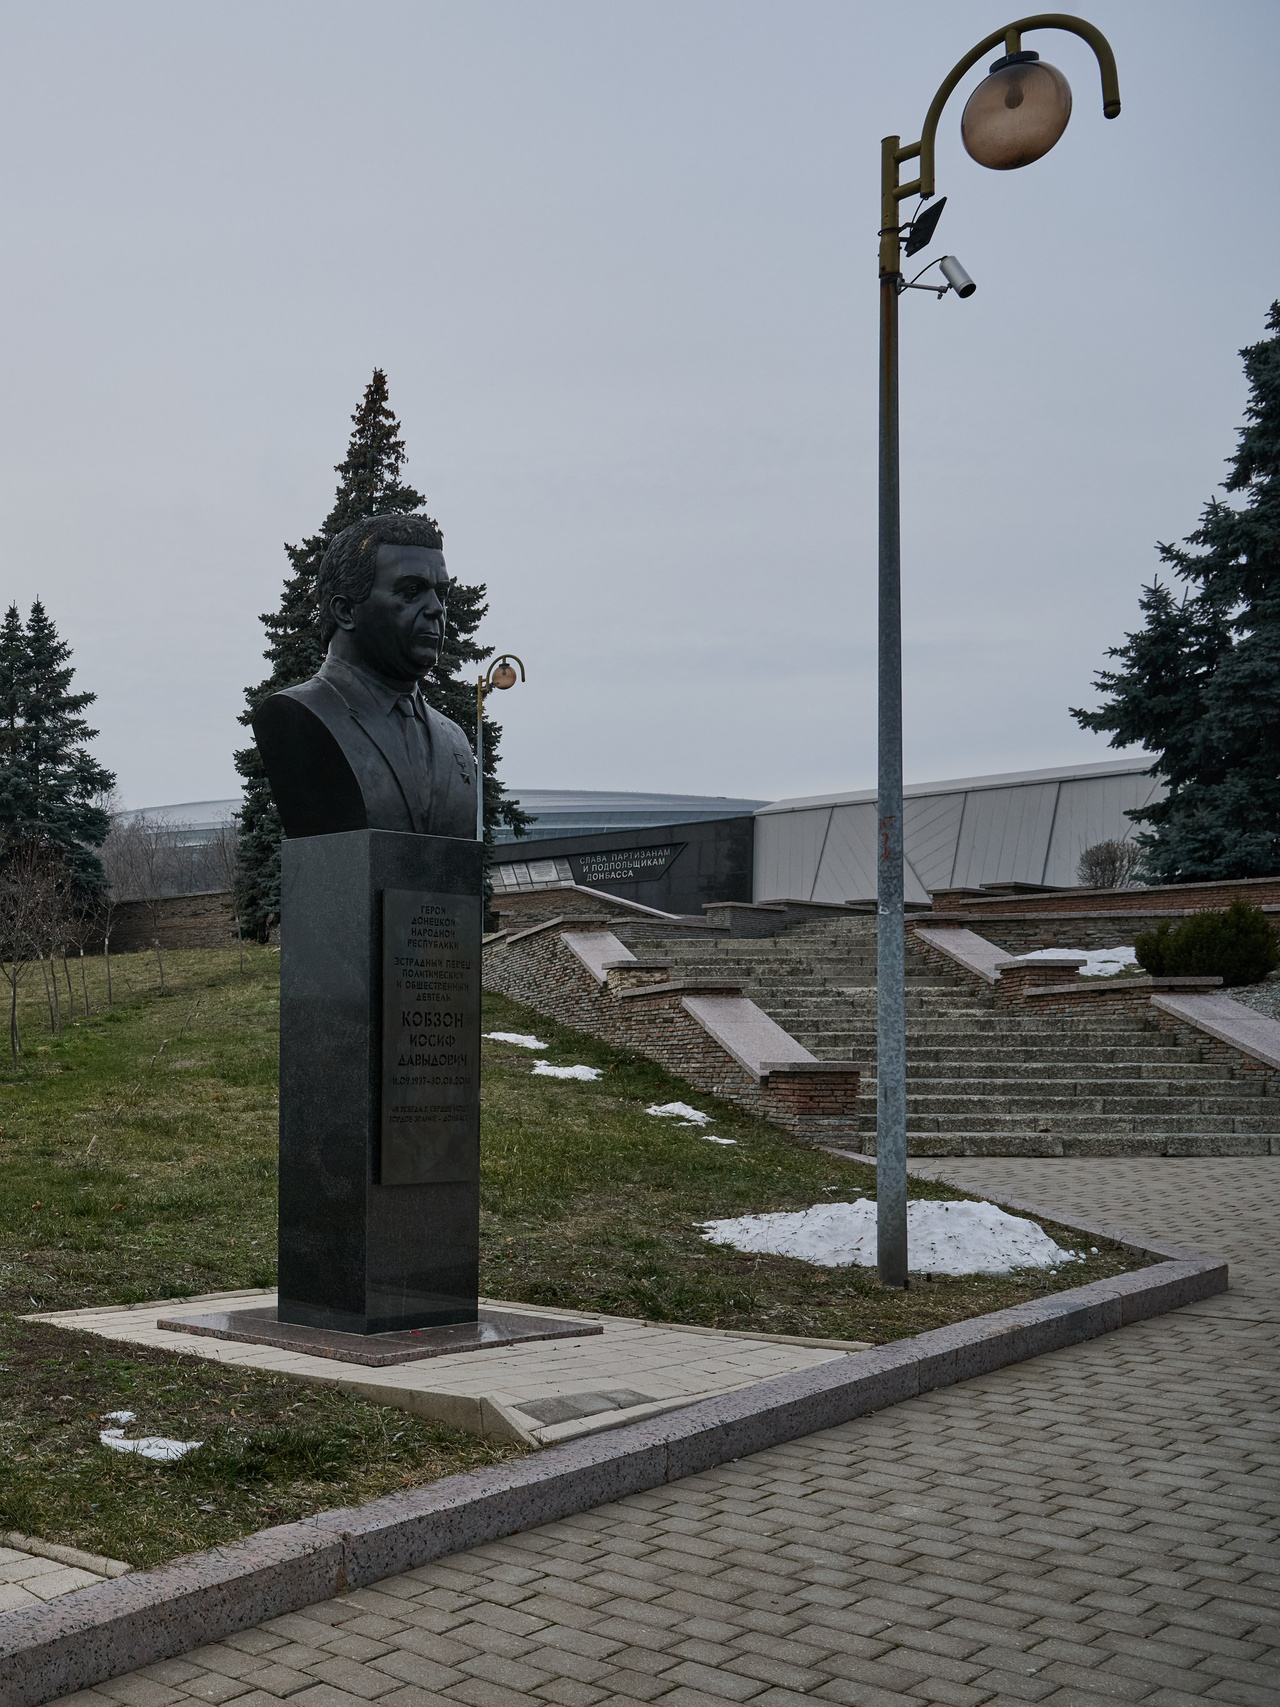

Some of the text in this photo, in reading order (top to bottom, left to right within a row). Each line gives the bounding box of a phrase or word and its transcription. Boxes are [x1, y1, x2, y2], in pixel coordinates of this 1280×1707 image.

[580, 848, 671, 864] СЛАВА ПАРТИЗАНАМ
[583, 865, 589, 873] И
[592, 858, 665, 872] ПОДПОЛЬЩИКАМ
[586, 870, 634, 882] ДОНБАССА
[421, 905, 446, 915] ГЕРОЙ
[411, 916, 456, 927] ДОНЕЦКОЙ
[411, 928, 455, 938] НАРОДНОЙ
[408, 939, 459, 950] РЕСПУБЛИКИ
[394, 957, 471, 969] ЭСТРАДНЫЙ ПЕВЕЦ
[402, 969, 464, 979] ПОЛИТИЧЕСКИЙ
[396, 980, 469, 991] И ОБЩЕСТВЕННЫЙ
[416, 993, 451, 1002] ДЕЯТЕЛЬ
[402, 1011, 463, 1028] КОБЗОН
[410, 1034, 456, 1047] ИОСИФ
[398, 1054, 467, 1067] ДАВЫДОВИЧ
